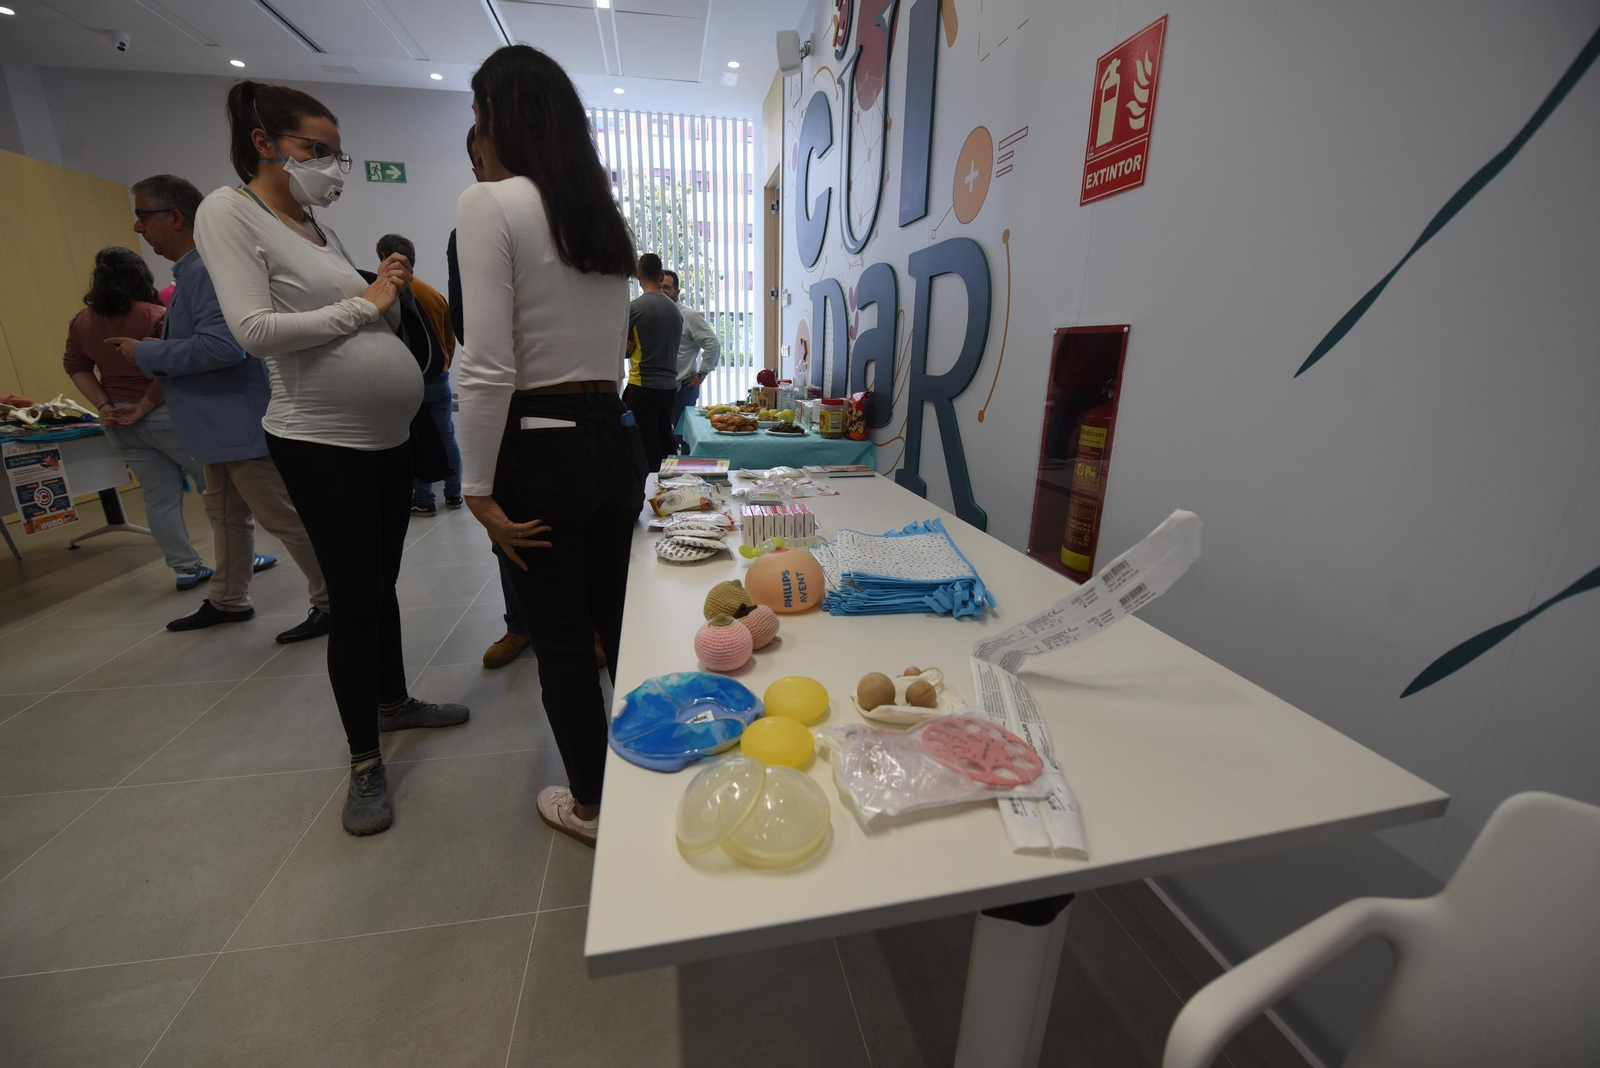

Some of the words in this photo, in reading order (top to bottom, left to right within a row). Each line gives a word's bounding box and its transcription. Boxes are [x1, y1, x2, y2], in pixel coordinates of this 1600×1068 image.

[1085, 153, 1143, 190] EXTINTOR
[781, 569, 794, 608] PHILIPS
[795, 571, 808, 603] AVENT
